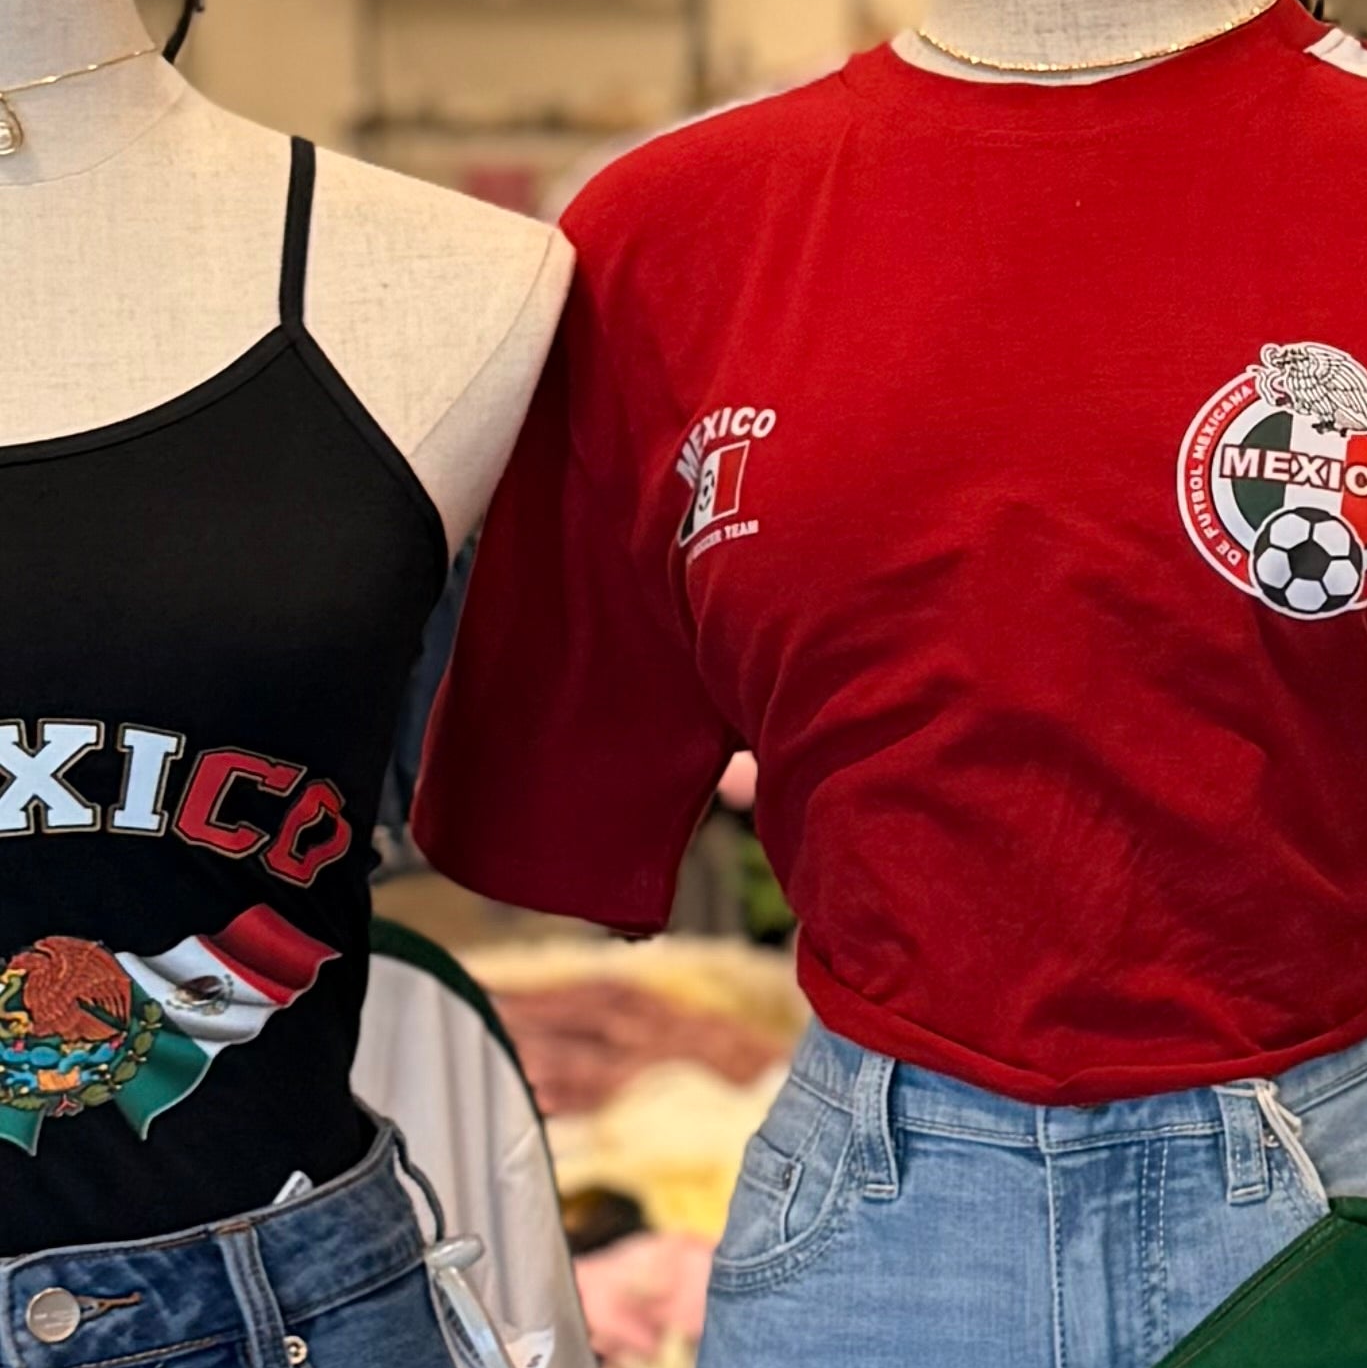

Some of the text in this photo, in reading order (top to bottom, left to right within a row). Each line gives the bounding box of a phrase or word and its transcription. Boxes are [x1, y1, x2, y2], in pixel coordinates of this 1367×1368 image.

[675, 406, 777, 489] MEXICO
[1192, 384, 1254, 461] MEXICANA
[724, 519, 759, 540] TEAM
[1189, 463, 1220, 540] FUTBOL
